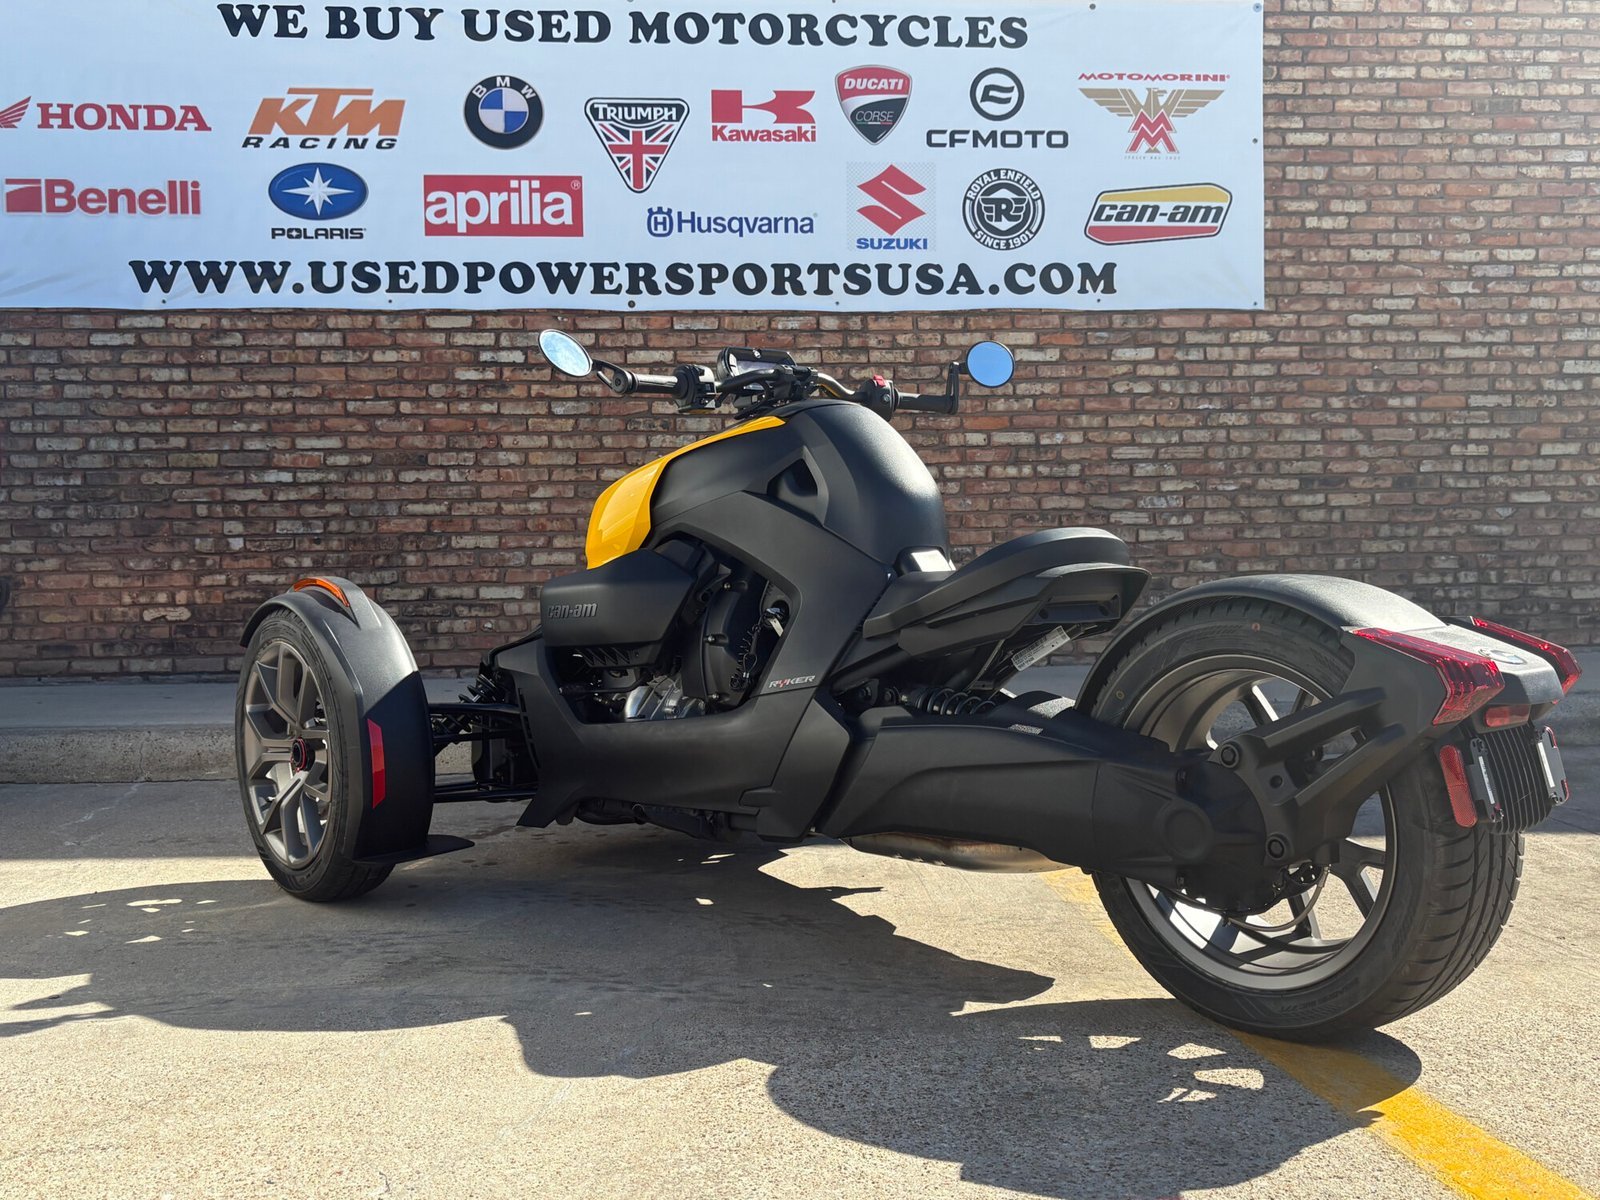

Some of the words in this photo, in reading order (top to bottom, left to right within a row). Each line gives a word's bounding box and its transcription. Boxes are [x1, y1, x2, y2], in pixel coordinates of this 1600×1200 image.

[217, 4, 308, 38] WE
[325, 6, 444, 40] BUY
[461, 8, 611, 43] USED
[629, 11, 1028, 49] MOTORCYCLES
[472, 76, 536, 99] BMW
[844, 78, 904, 90] DUCATI
[37, 103, 212, 132] HONDA
[248, 88, 405, 136] KTM
[594, 104, 677, 121] TRIUMPH
[855, 111, 895, 122] CORSE
[242, 136, 397, 149] RACING
[712, 125, 817, 143] Kawasaki
[926, 129, 1069, 148] CFMOTO
[966, 171, 998, 200] ROYAL
[1000, 169, 1041, 200] ENFIELD
[45, 179, 201, 215] Benelli
[425, 179, 573, 233] aprilia
[1093, 204, 1224, 223] can-am
[271, 228, 364, 239] POLARIS
[677, 211, 814, 237] Husqvarna
[856, 238, 927, 250] SUZUKI
[974, 230, 1006, 249] SINCE
[1009, 230, 1034, 249] 1901
[129, 260, 1117, 296] WWW.USEDPOWERSPORTSUSA.COM
[548, 603, 598, 618] can-am
